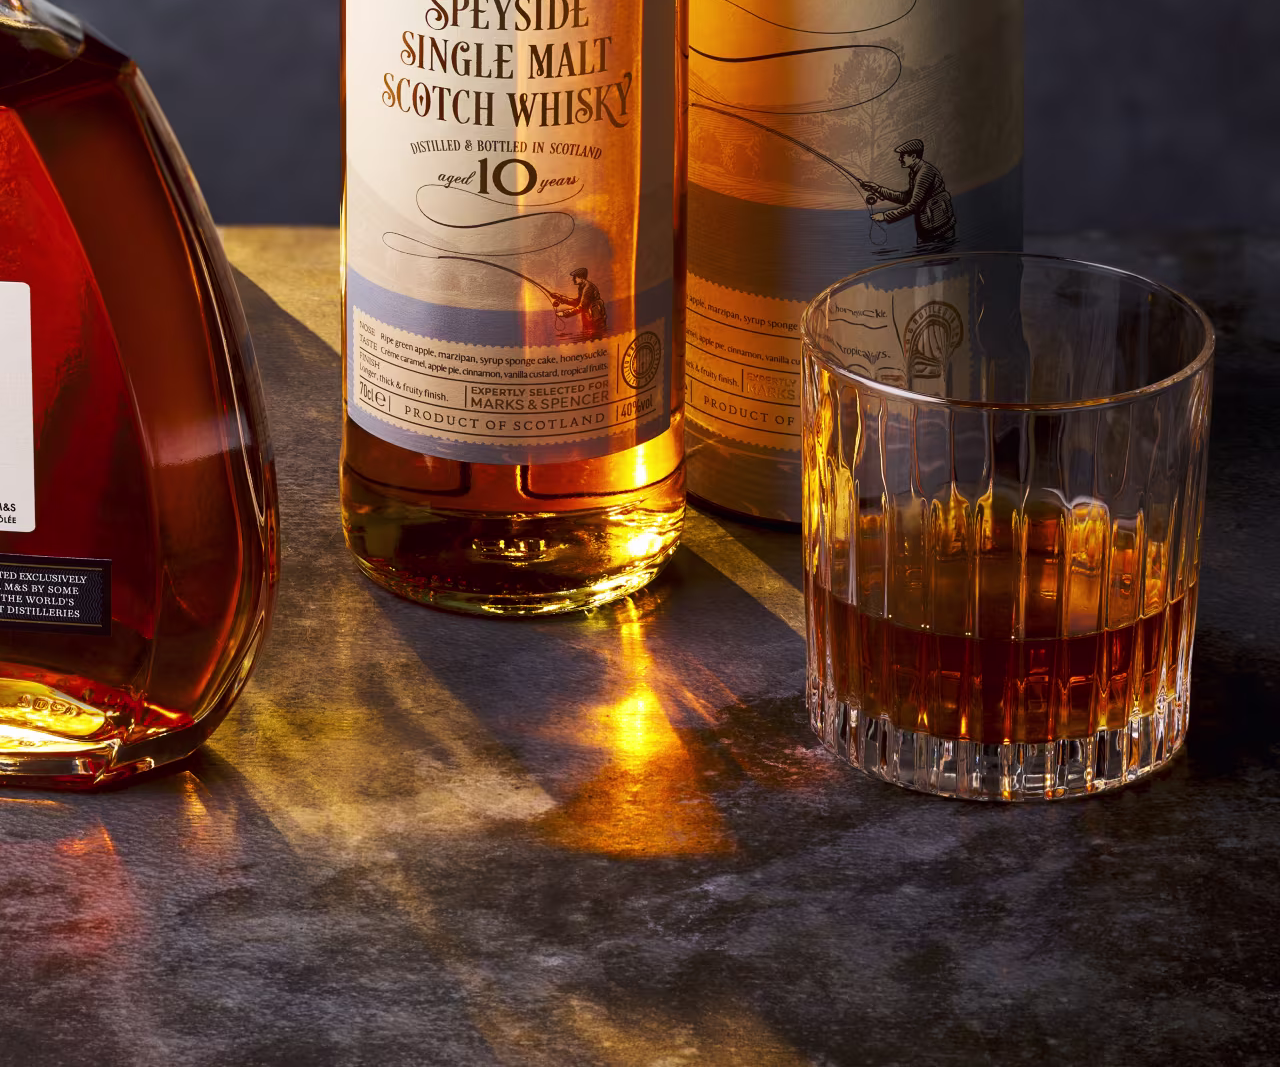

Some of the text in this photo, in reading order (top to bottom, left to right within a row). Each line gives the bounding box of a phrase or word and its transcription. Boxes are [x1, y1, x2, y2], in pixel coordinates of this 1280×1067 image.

[400, 31, 612, 79] SINGLE MALT
[382, 71, 633, 128] SCOTCH WHISKY
[410, 139, 602, 159] DISTILLED & BOTTLED IN SCOTLAND
[438, 157, 579, 196] aged 10 years
[471, 380, 608, 397] EXPERTLY SELECTED FOR
[471, 391, 608, 410] MARKS & SPENCER
[405, 405, 605, 431] PRODUCT OF SCOTLAND
